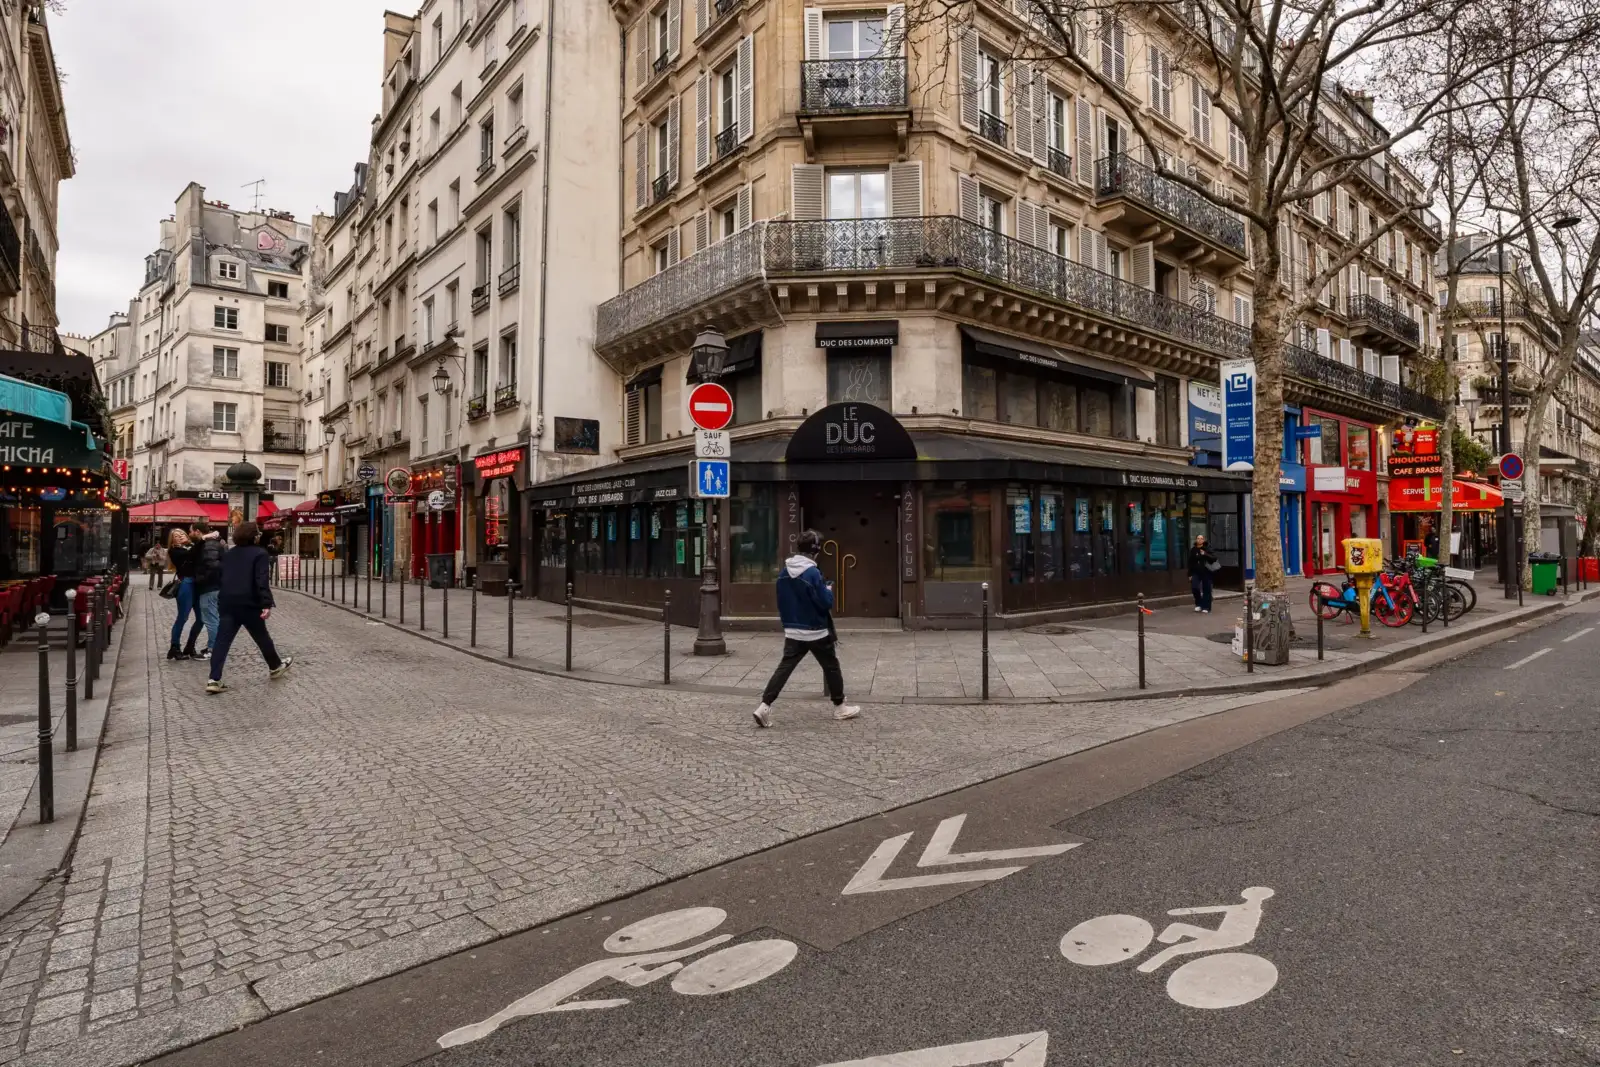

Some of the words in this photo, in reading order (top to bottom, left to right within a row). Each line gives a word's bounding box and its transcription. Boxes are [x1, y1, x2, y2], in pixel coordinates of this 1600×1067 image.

[854, 338, 894, 346] LOMBARDS
[1020, 353, 1028, 361] DUC
[1197, 387, 1209, 398] NET
[1216, 392, 1220, 400] E
[844, 406, 858, 420] LE
[0, 421, 34, 438] AFE
[826, 422, 875, 444] DUC
[826, 446, 838, 454] DES
[841, 445, 875, 453] LOMBARDS
[0, 446, 54, 464] HICHA
[1388, 456, 1440, 464] CHOUCHOU
[624, 478, 635, 487] CLUB
[1140, 476, 1150, 484] DES
[578, 496, 587, 504] DUC
[588, 495, 597, 504] DES
[599, 492, 624, 502] LOMBARDS
